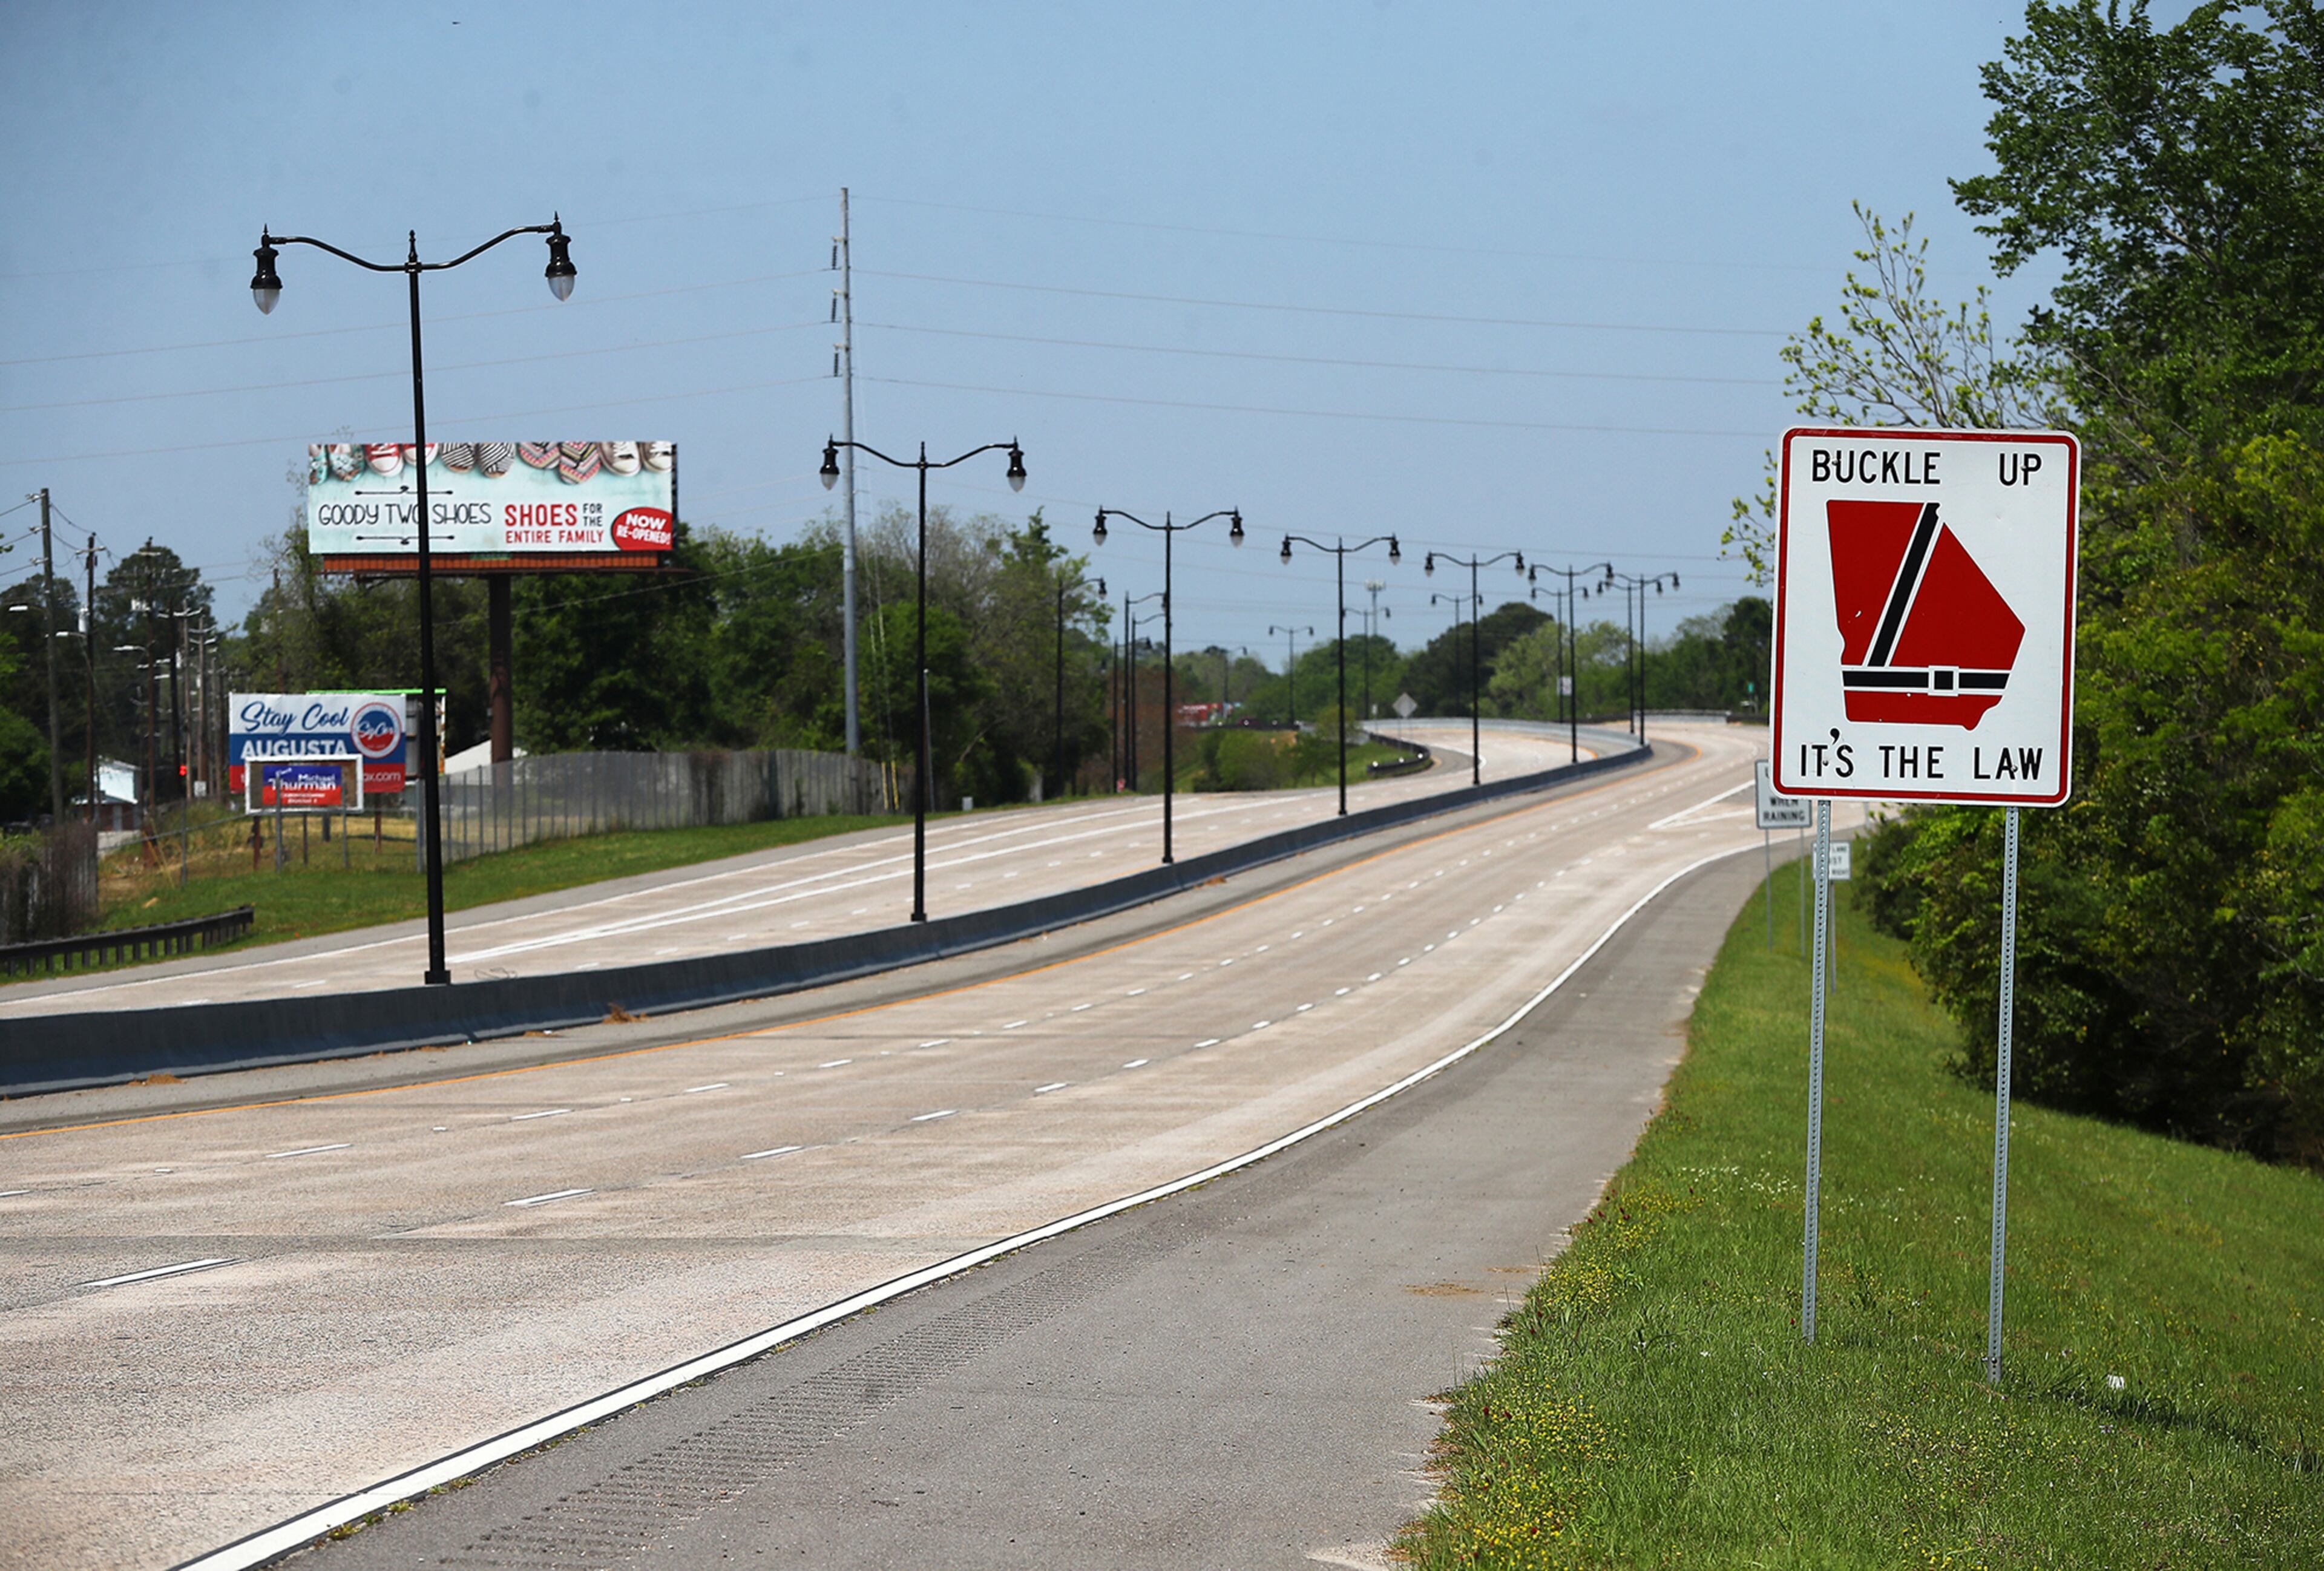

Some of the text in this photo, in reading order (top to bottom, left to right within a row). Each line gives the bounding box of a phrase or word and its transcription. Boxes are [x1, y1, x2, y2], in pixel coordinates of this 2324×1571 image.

[1812, 449, 2042, 486] BUCKLE UP
[318, 503, 379, 525] GOODY
[432, 502, 492, 525] SHOES
[505, 503, 577, 526] SHOES
[582, 503, 603, 514] FOR
[583, 516, 603, 526] THE
[625, 512, 667, 530] NOW
[505, 530, 604, 543] ENTIRE FAMILY
[240, 701, 297, 736] Stay
[302, 703, 349, 730] Cool
[241, 740, 348, 759] AUGUSTA
[1800, 727, 2043, 781] IT'S THE LAW
[1763, 810, 1805, 821] RAINING
